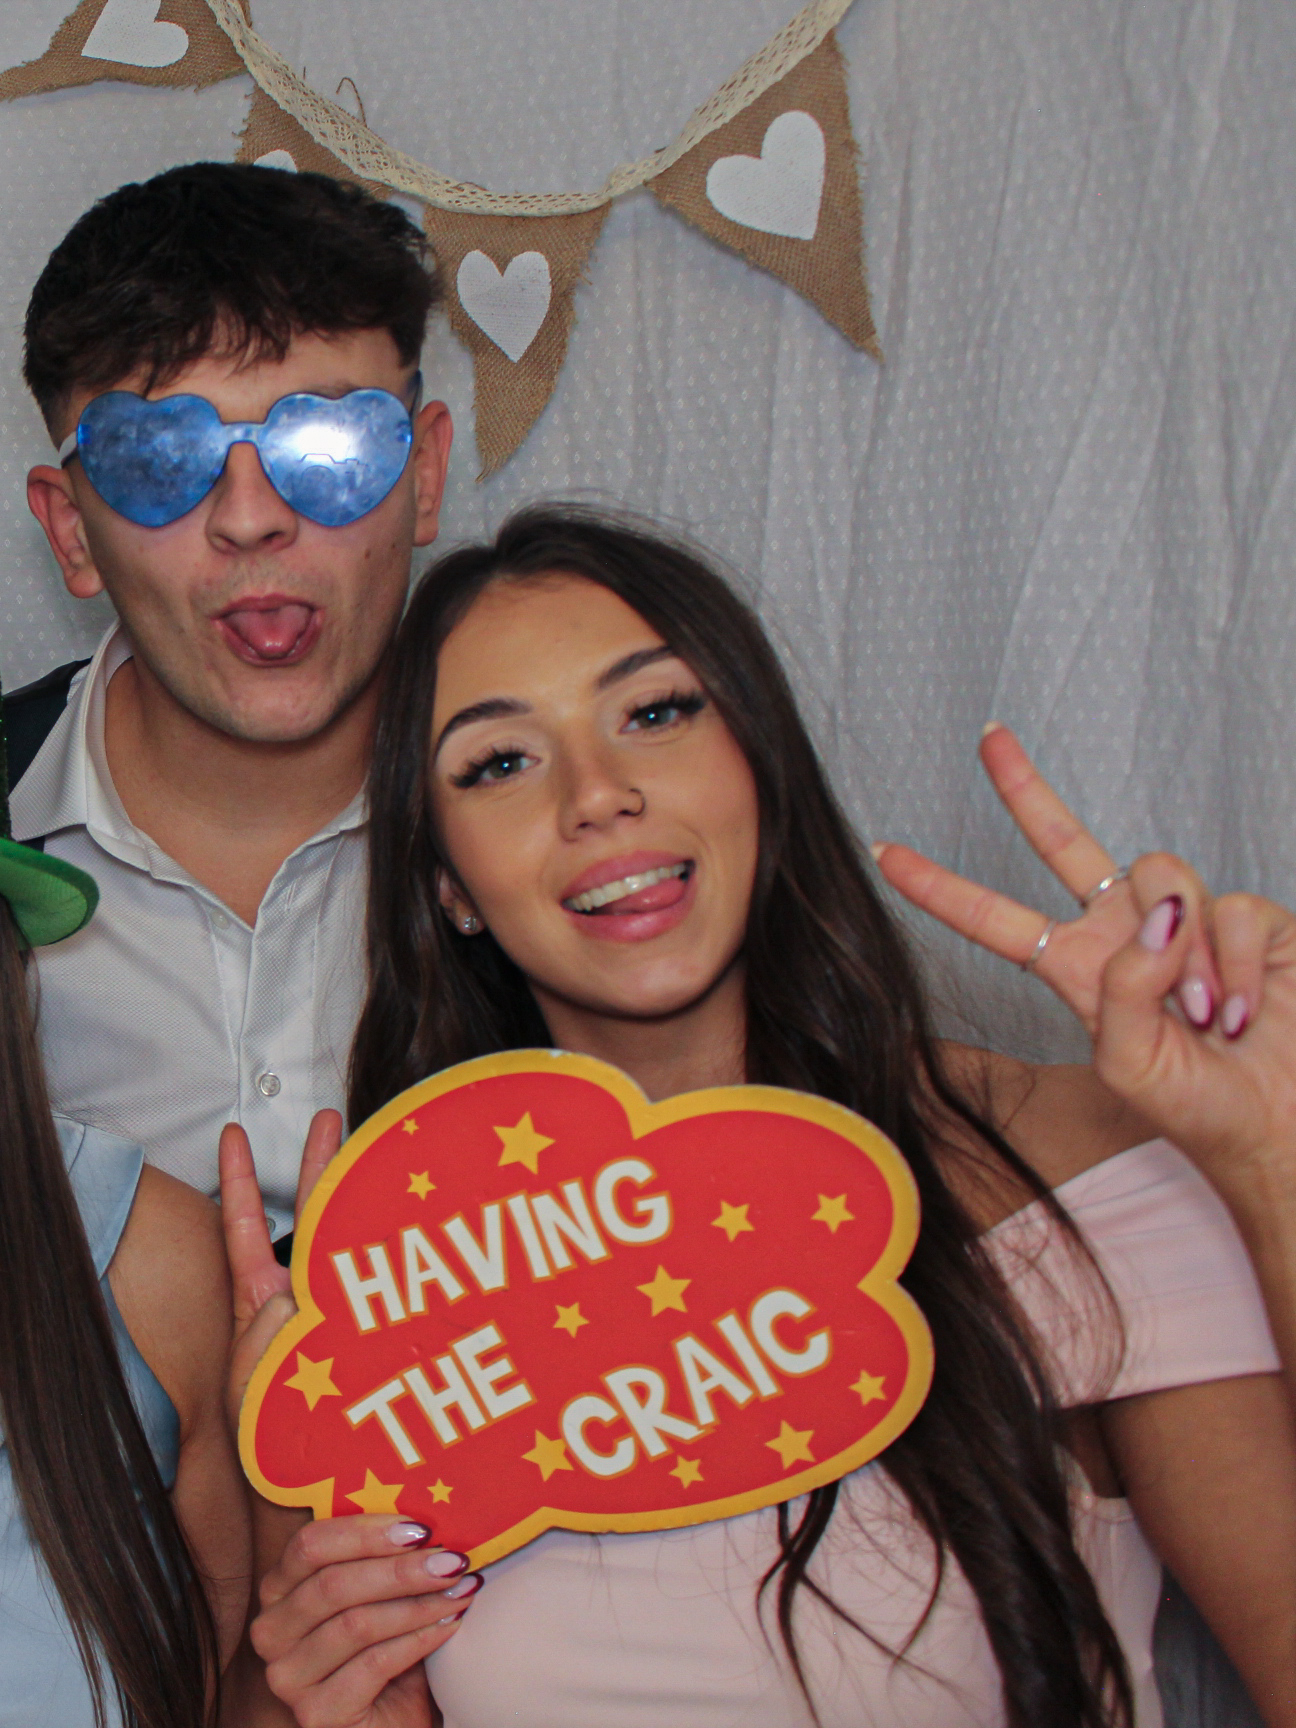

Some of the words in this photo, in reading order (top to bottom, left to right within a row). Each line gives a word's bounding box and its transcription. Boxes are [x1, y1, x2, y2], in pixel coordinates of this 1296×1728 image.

[332, 1159, 671, 1331] HAVING
[346, 1324, 533, 1466] THE
[561, 1289, 831, 1477] CRAIC
